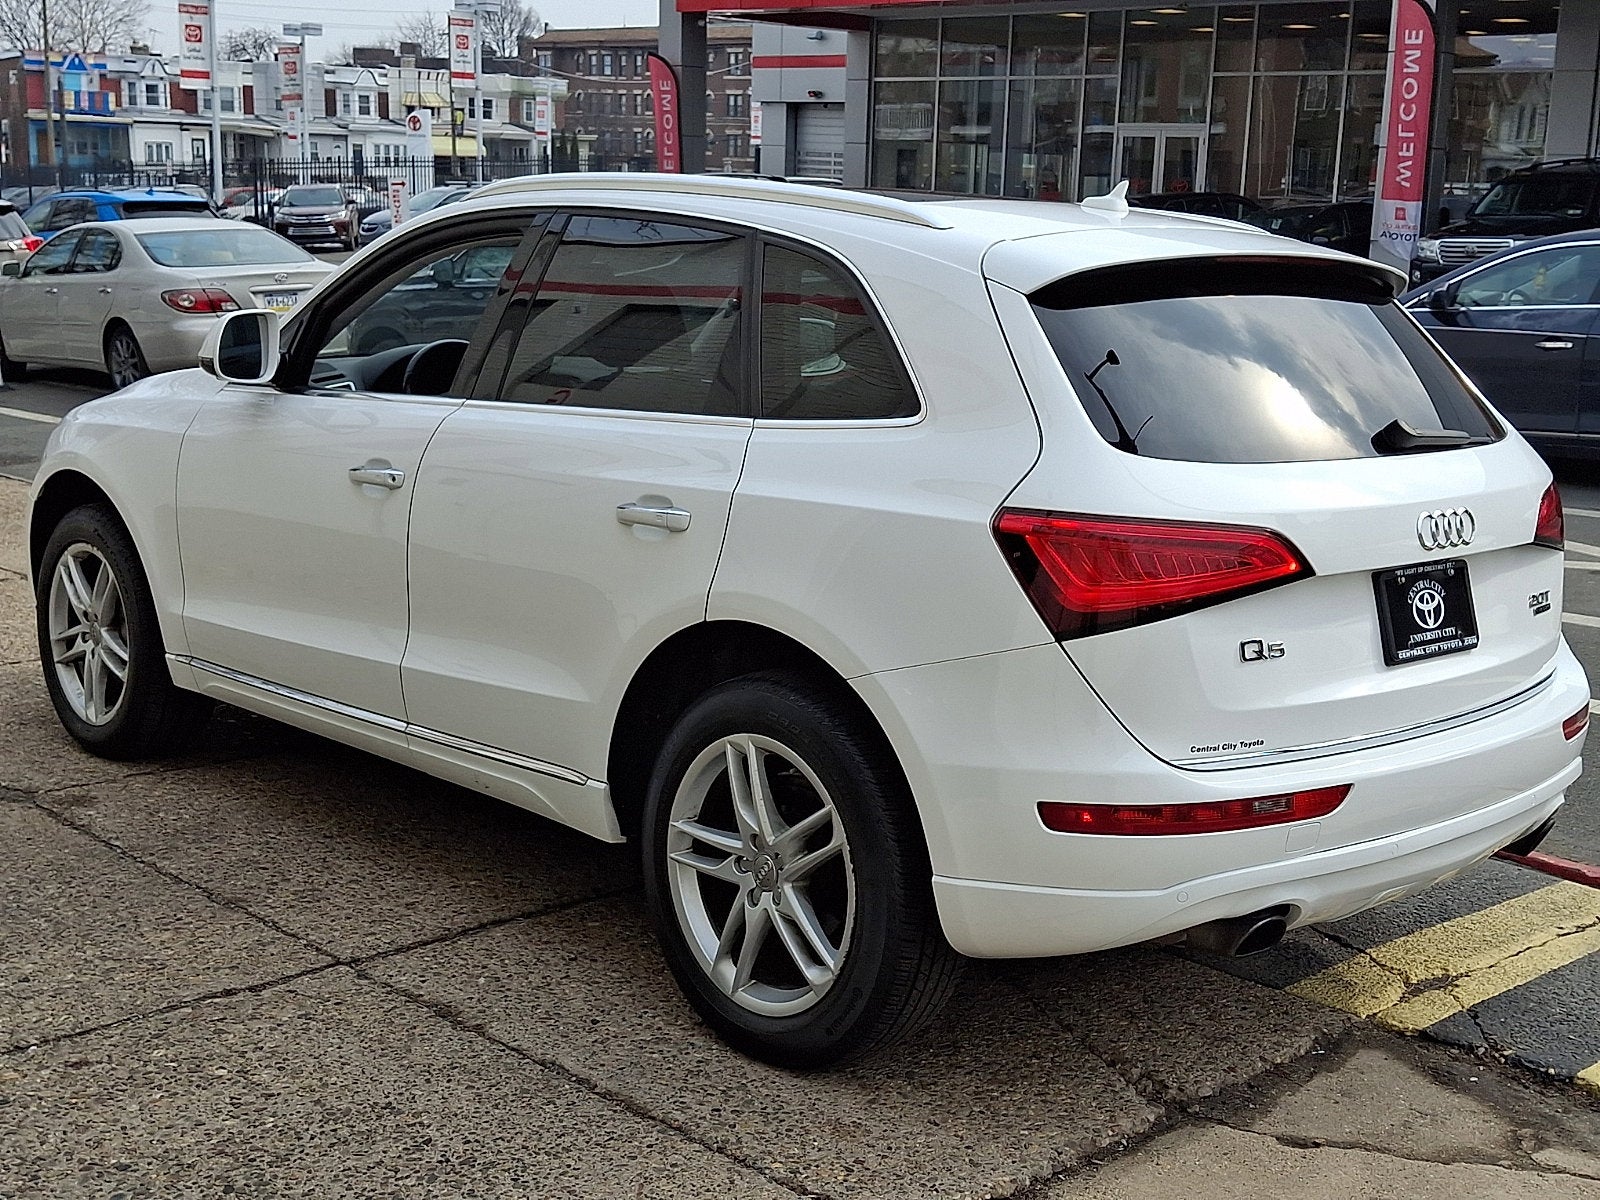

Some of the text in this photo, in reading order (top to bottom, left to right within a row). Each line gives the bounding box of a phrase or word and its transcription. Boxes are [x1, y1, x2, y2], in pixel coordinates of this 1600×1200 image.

[1407, 579, 1446, 604] CENTRAL CITY
[1410, 627, 1456, 643] UNIVERSITY CITY
[1239, 640, 1285, 663] Q5
[1398, 648, 1425, 659] CENTRAL
[1425, 646, 1439, 654] CITY
[1440, 641, 1462, 651] TOYOTA
[1190, 739, 1265, 753] Central City Toyota
